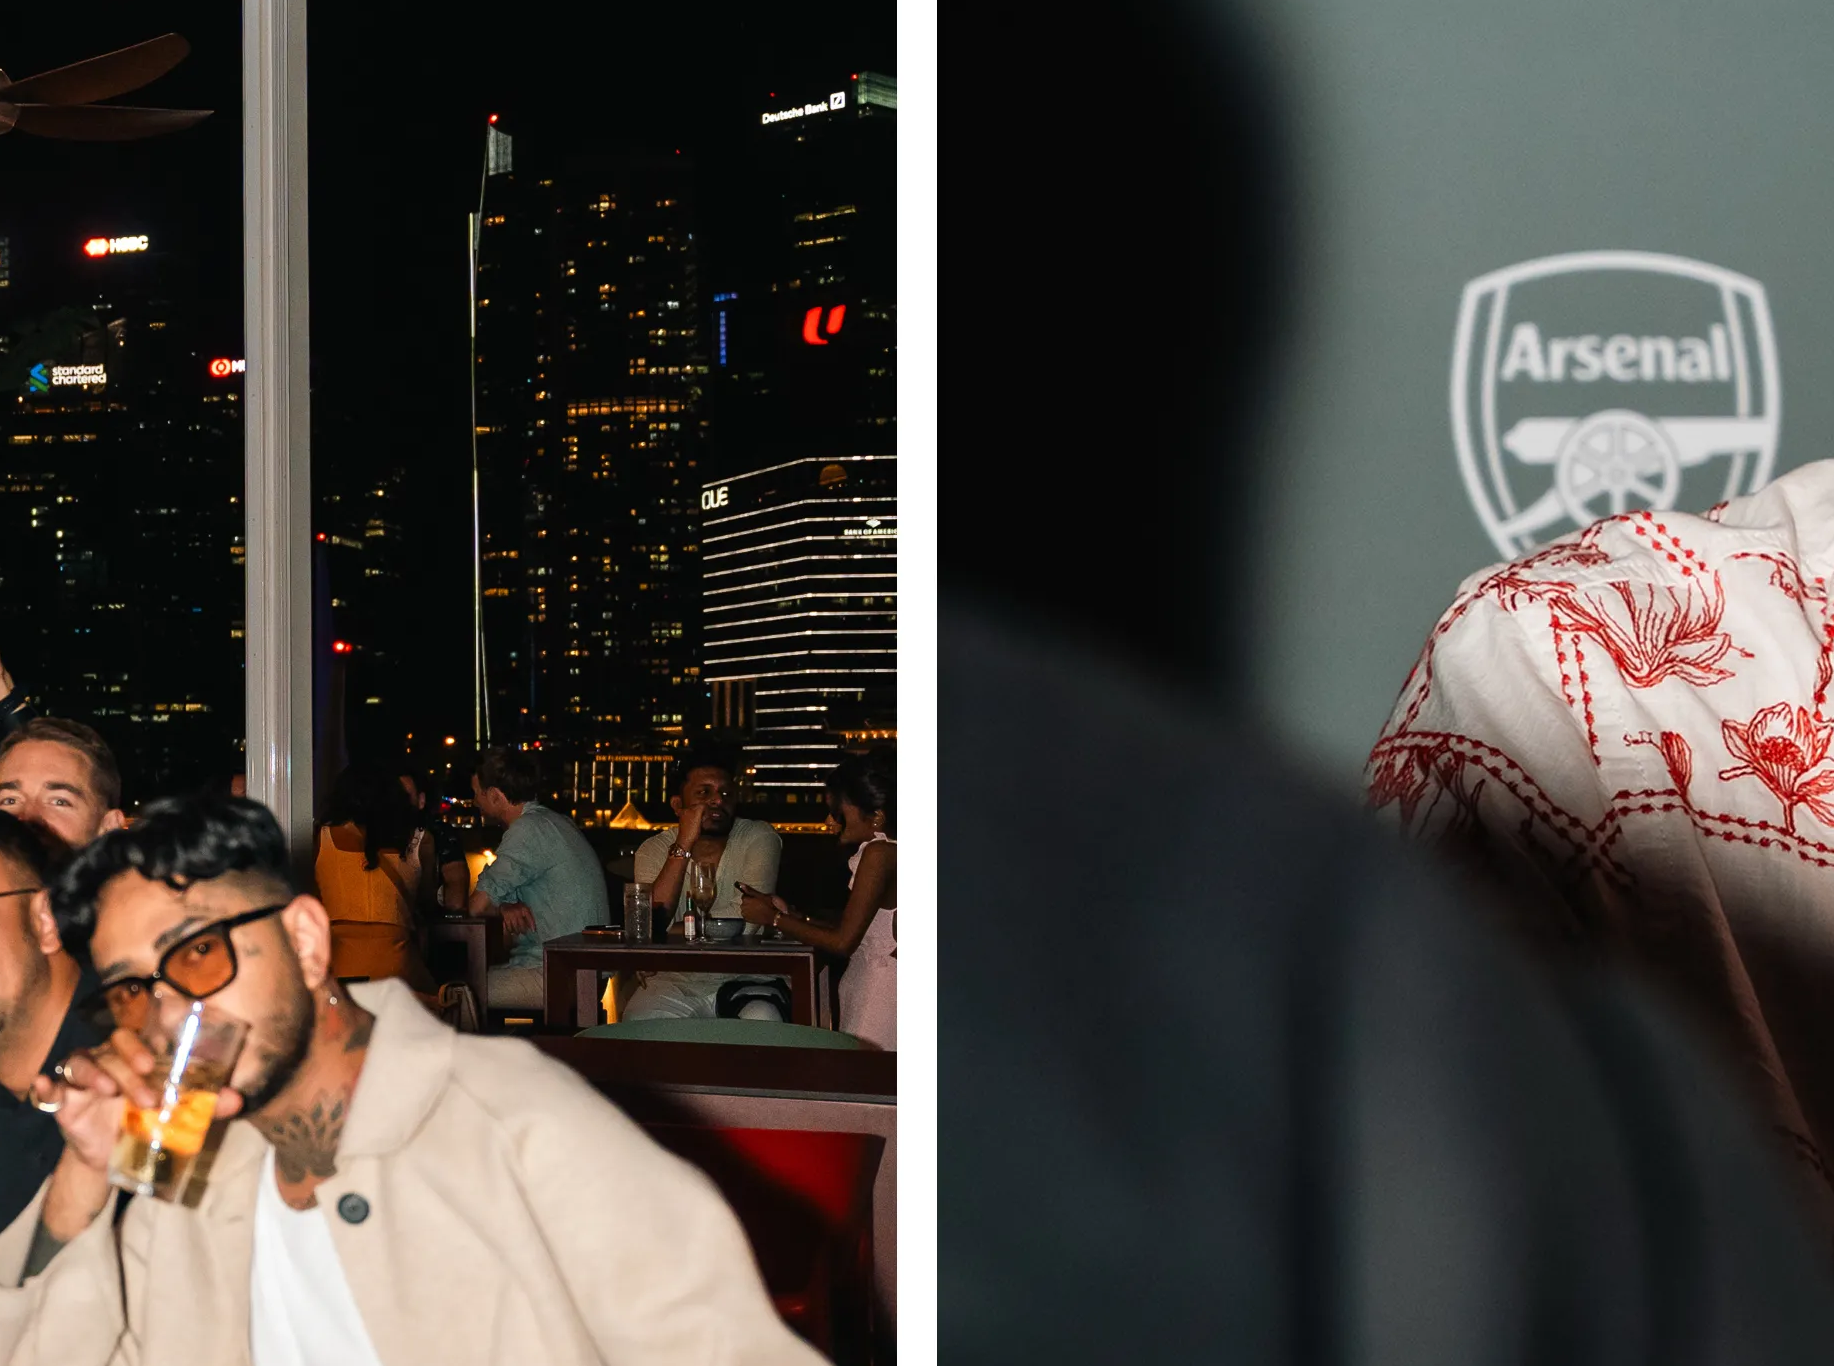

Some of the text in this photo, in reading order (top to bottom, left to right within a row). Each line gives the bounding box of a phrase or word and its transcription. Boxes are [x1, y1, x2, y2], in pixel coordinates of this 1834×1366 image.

[762, 101, 828, 124] Deutsche Bank
[1500, 321, 1731, 382] Arsenal
[52, 364, 104, 376] standard
[52, 373, 107, 385] chartered
[702, 486, 729, 510] OUE
